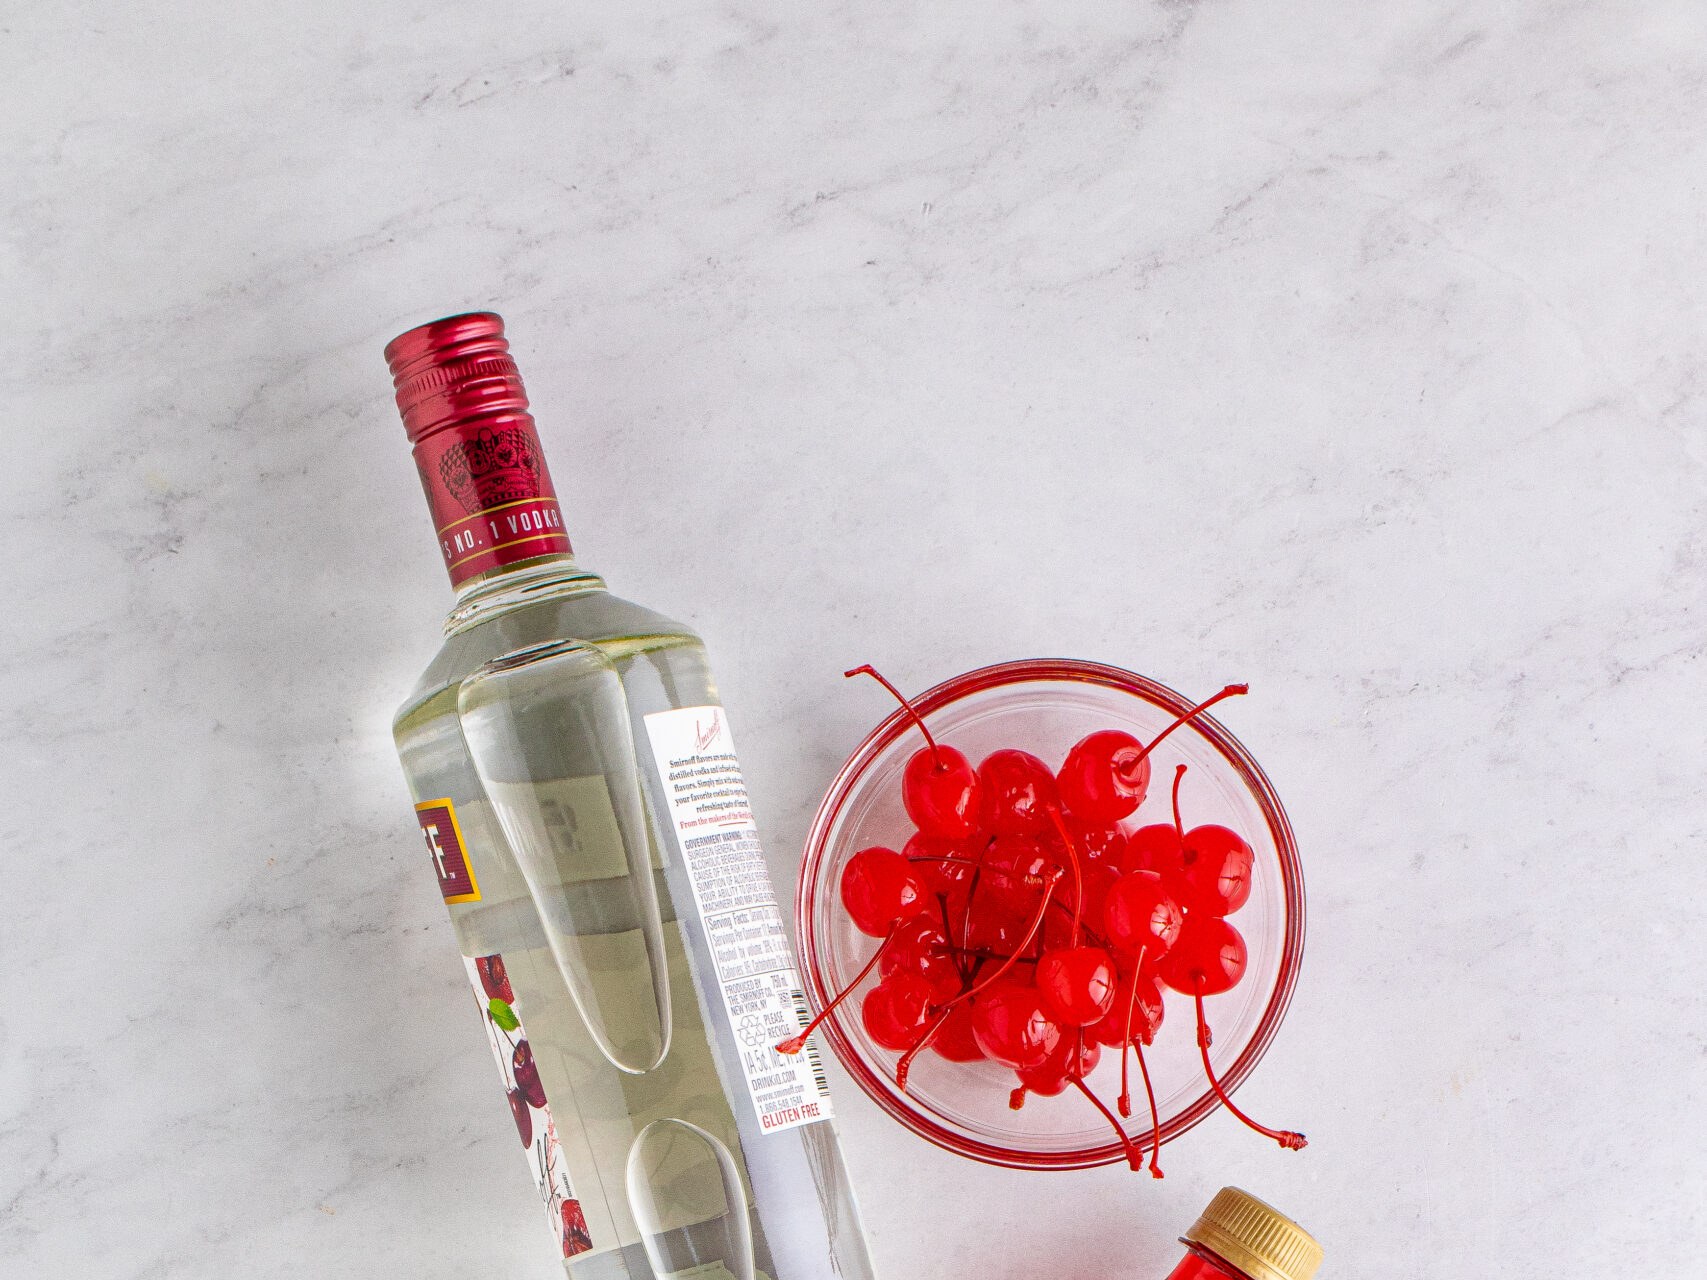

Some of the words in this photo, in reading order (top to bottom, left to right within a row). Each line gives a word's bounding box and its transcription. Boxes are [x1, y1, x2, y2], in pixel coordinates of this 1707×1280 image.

[454, 530, 482, 553] NO.
[489, 521, 499, 539] 1
[507, 509, 560, 534] VODKA
[669, 756, 695, 768] Smirnoff
[668, 769, 693, 781] distilled
[694, 766, 709, 775] vodka
[697, 778, 714, 788] Simply
[675, 796, 689, 806] your
[690, 791, 712, 801] favorite
[695, 802, 723, 813] refreshing
[680, 819, 697, 830] From
[697, 816, 709, 827] the
[708, 814, 727, 826] makers
[685, 834, 721, 849] GOVERNMENT
[421, 823, 446, 880] F
[687, 846, 714, 860] SURGEON
[690, 856, 720, 870] ALCOHOLIC
[693, 868, 712, 881] CAUSE
[712, 866, 720, 877] OF
[720, 865, 731, 875] THE
[696, 877, 726, 892] SUMPTION
[726, 875, 733, 885] OF
[699, 890, 716, 902] YOUR
[717, 886, 738, 898] ABILITY
[709, 914, 733, 931] Serving
[724, 979, 754, 995] PRODUCED
[753, 978, 761, 989] BY
[727, 994, 739, 1005] THE
[739, 988, 764, 1002] SMIRNOFF
[730, 1004, 744, 1016] NEW
[759, 999, 767, 1008] NY
[763, 1011, 784, 1025] PLEASE
[767, 1023, 791, 1038] RECYCLE
[762, 1107, 800, 1127] GLUTEN
[800, 1102, 820, 1118] FREE
